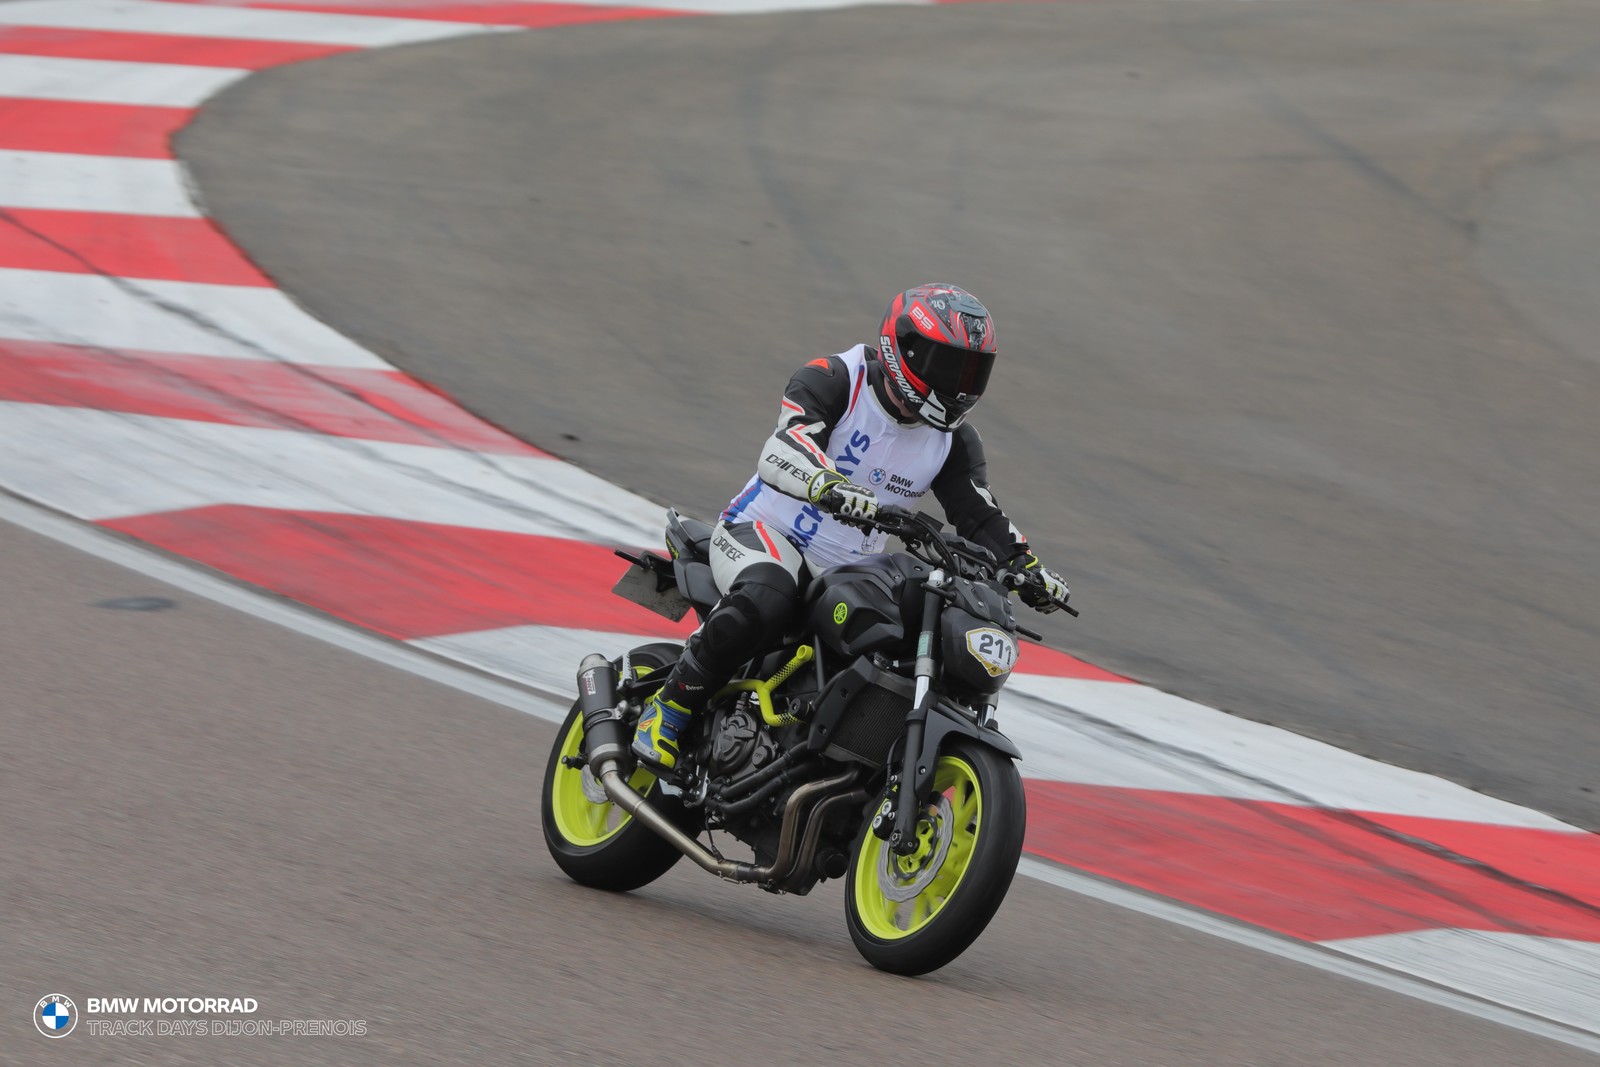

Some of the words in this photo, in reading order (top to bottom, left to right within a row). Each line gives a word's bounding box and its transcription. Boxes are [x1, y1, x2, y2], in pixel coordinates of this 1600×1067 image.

[912, 306, 935, 330] BS
[880, 335, 921, 402] SCORPION
[765, 453, 813, 485] DAINESE
[890, 474, 914, 488] BMW
[979, 633, 1012, 665] 211
